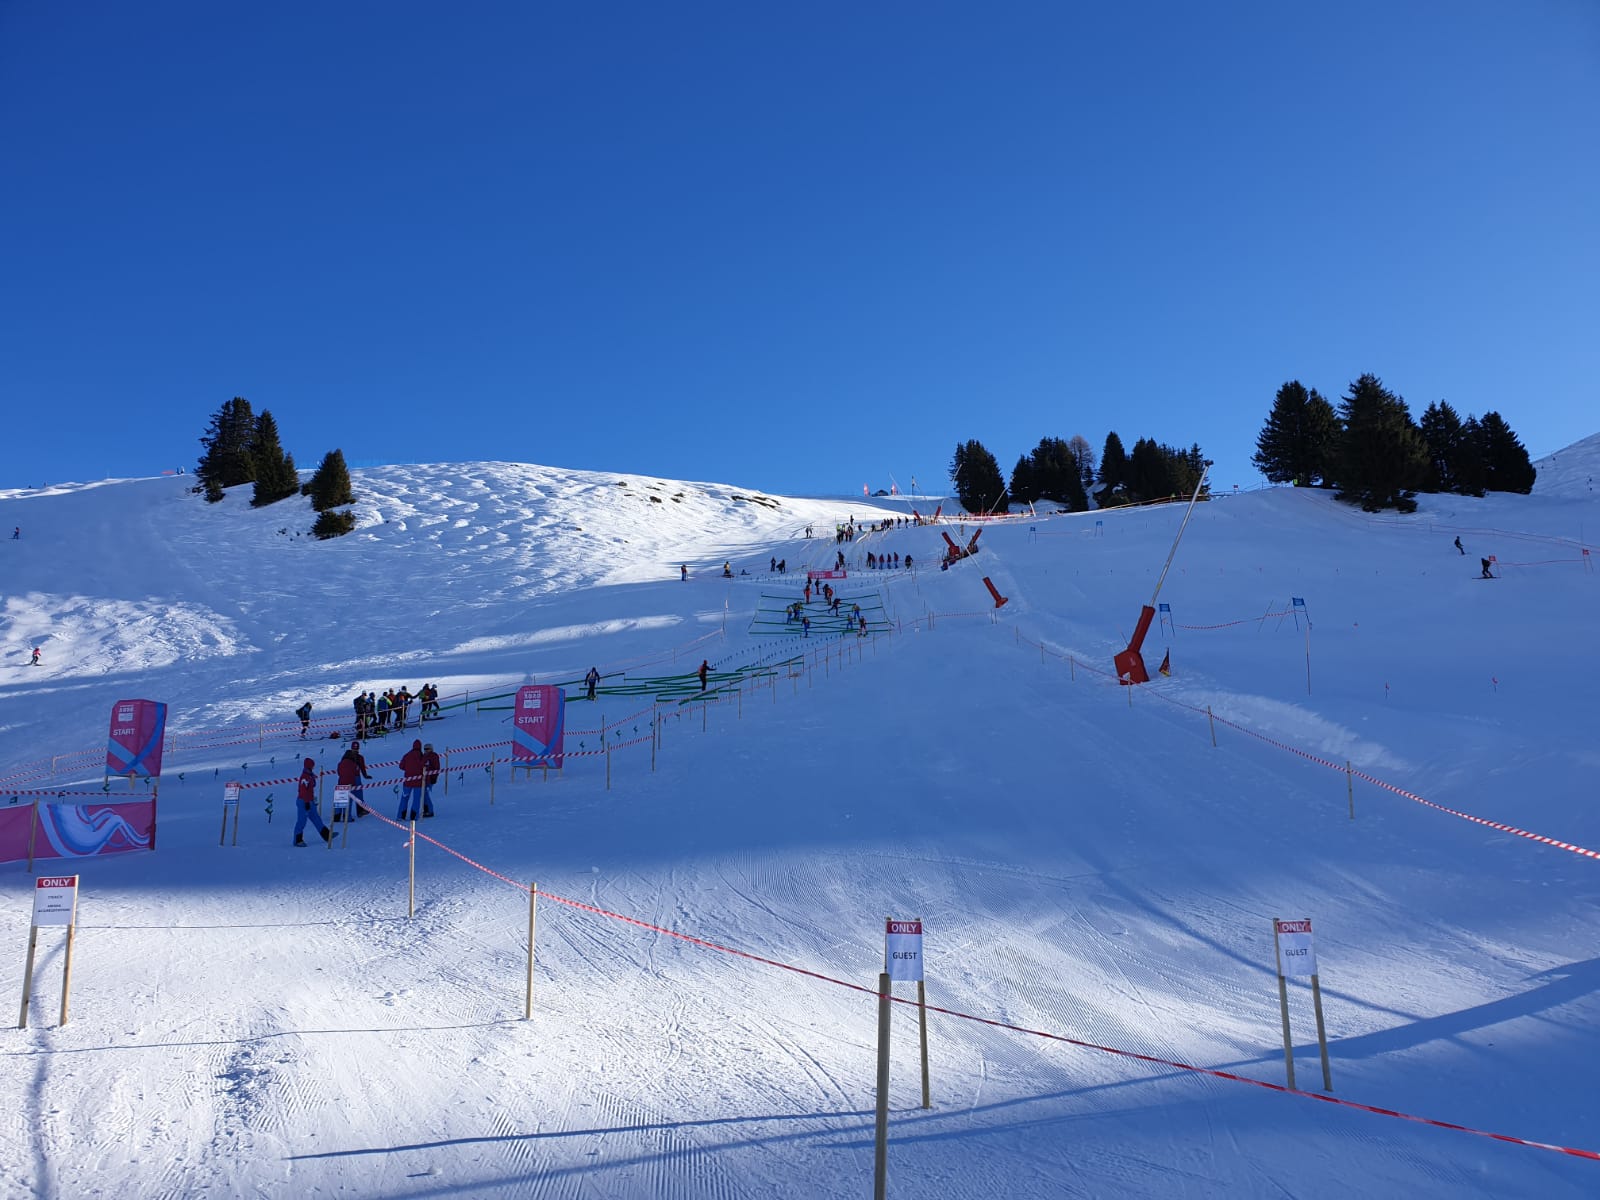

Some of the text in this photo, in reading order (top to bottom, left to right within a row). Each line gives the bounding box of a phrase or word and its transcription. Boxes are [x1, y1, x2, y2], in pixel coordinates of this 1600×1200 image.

[518, 716, 544, 724] START
[113, 728, 135, 736] START
[42, 879, 70, 887] ONLY
[891, 923, 917, 933] ONLY
[1281, 922, 1305, 932] ONLY
[892, 951, 918, 960] GUEST
[1285, 948, 1308, 957] GUEST
